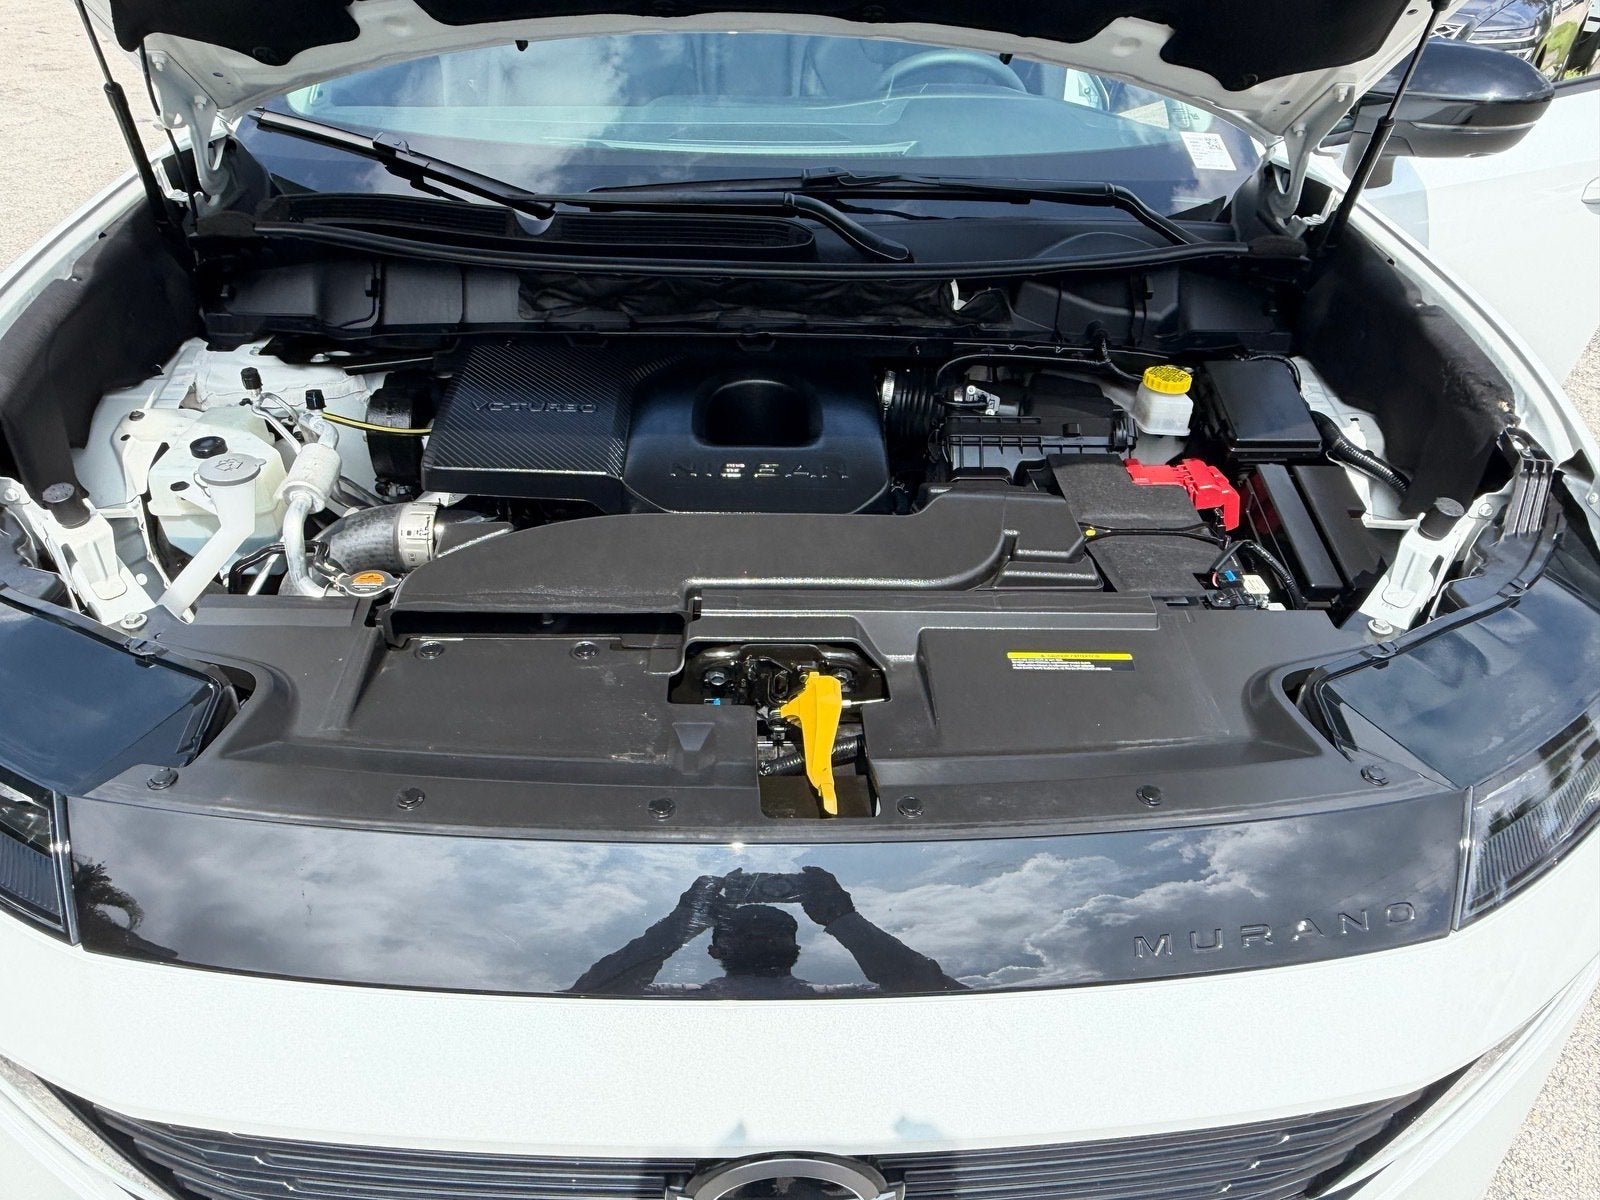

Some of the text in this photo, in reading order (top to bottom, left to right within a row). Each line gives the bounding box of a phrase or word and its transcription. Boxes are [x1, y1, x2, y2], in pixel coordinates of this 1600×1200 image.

[472, 401, 597, 413] VC-TURBO
[670, 461, 849, 479] NISSAN
[1134, 901, 1416, 958] MURANO
